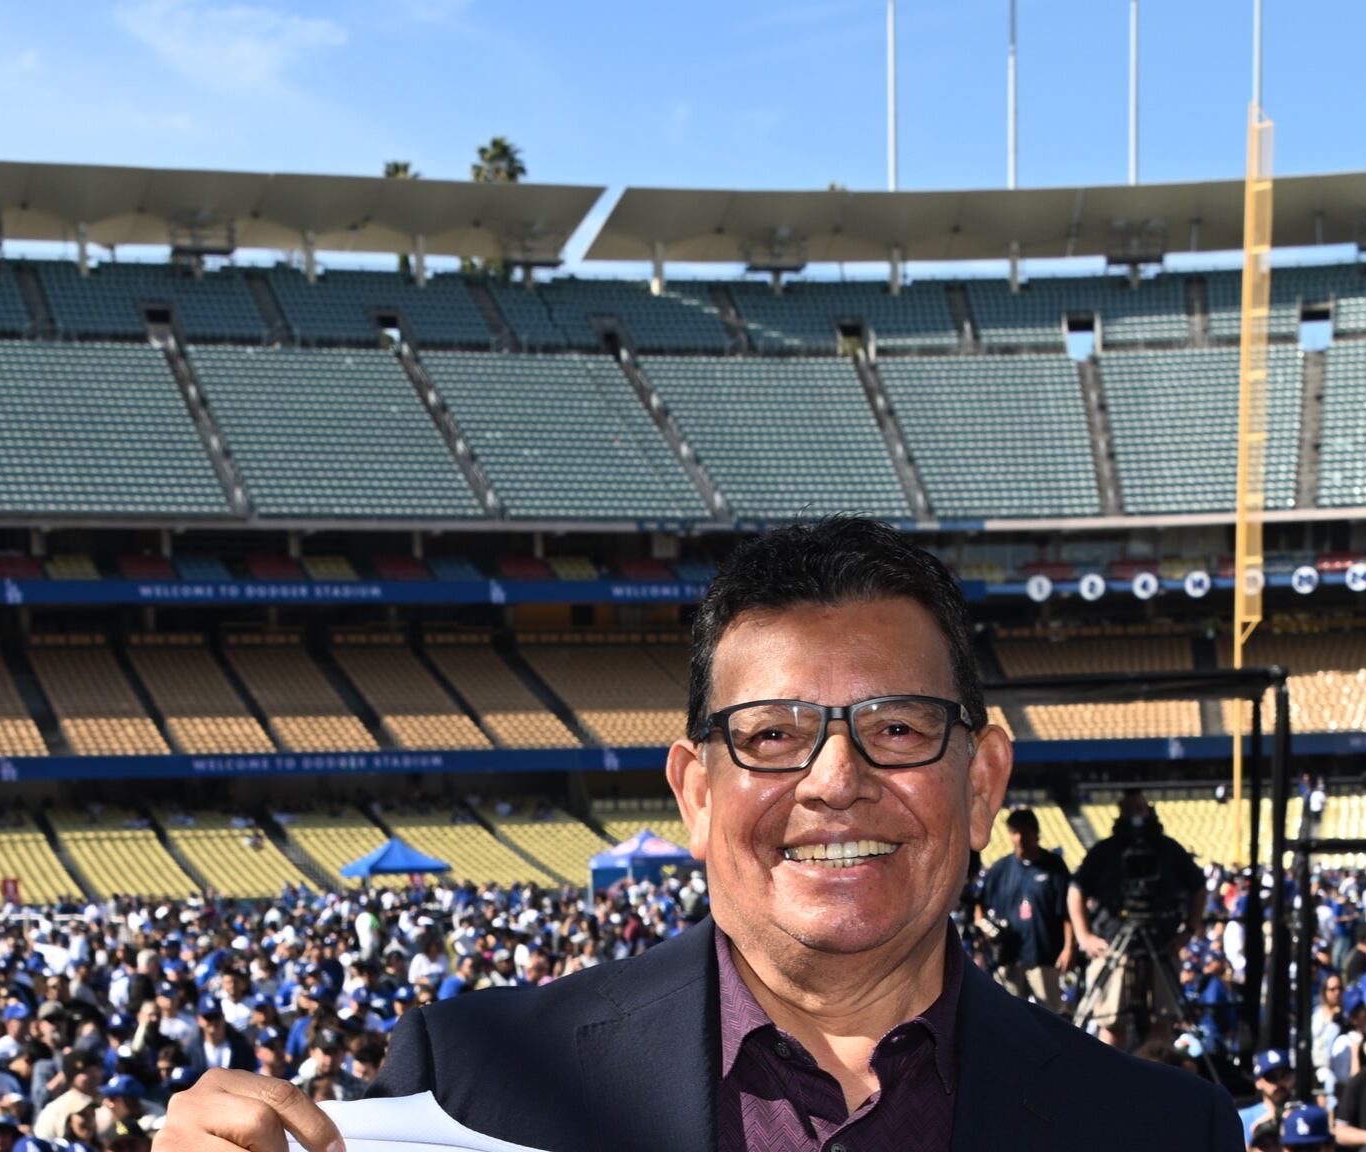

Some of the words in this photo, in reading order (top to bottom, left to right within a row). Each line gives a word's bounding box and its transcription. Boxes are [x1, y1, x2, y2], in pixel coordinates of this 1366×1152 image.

[139, 585, 214, 597] WELCOME
[220, 585, 239, 597] TO
[245, 585, 308, 597] DODGER
[314, 585, 382, 597] STADIUM
[611, 585, 680, 597] WELCOME
[192, 757, 269, 771] WELCOME
[275, 757, 295, 769] TO
[301, 757, 366, 770] DODGER
[372, 755, 443, 768] STADIUM
